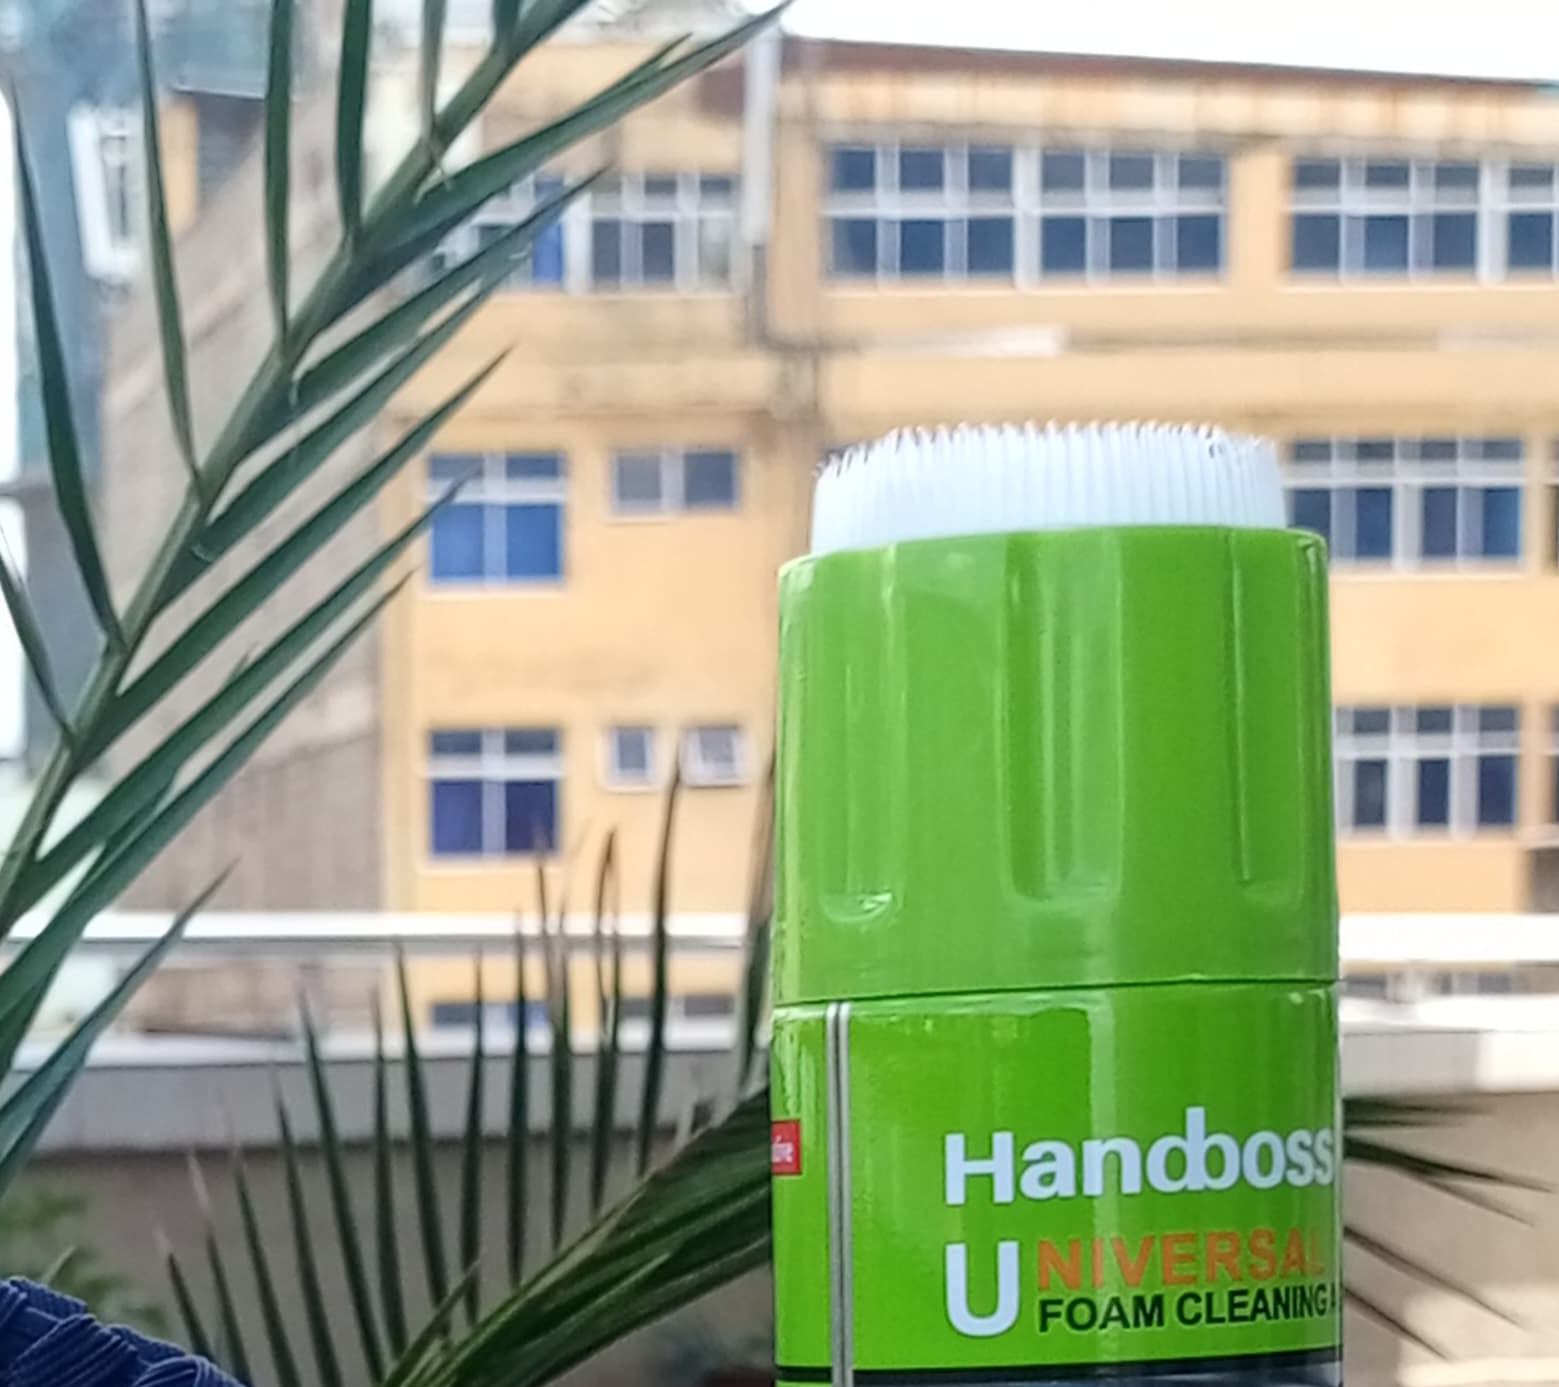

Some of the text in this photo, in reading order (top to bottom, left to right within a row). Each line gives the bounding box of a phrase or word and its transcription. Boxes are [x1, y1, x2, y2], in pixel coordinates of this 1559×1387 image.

[944, 1106, 1336, 1205] Handboss
[1038, 1292, 1165, 1332] FOAM
[1175, 1285, 1328, 1326] CLEANING
